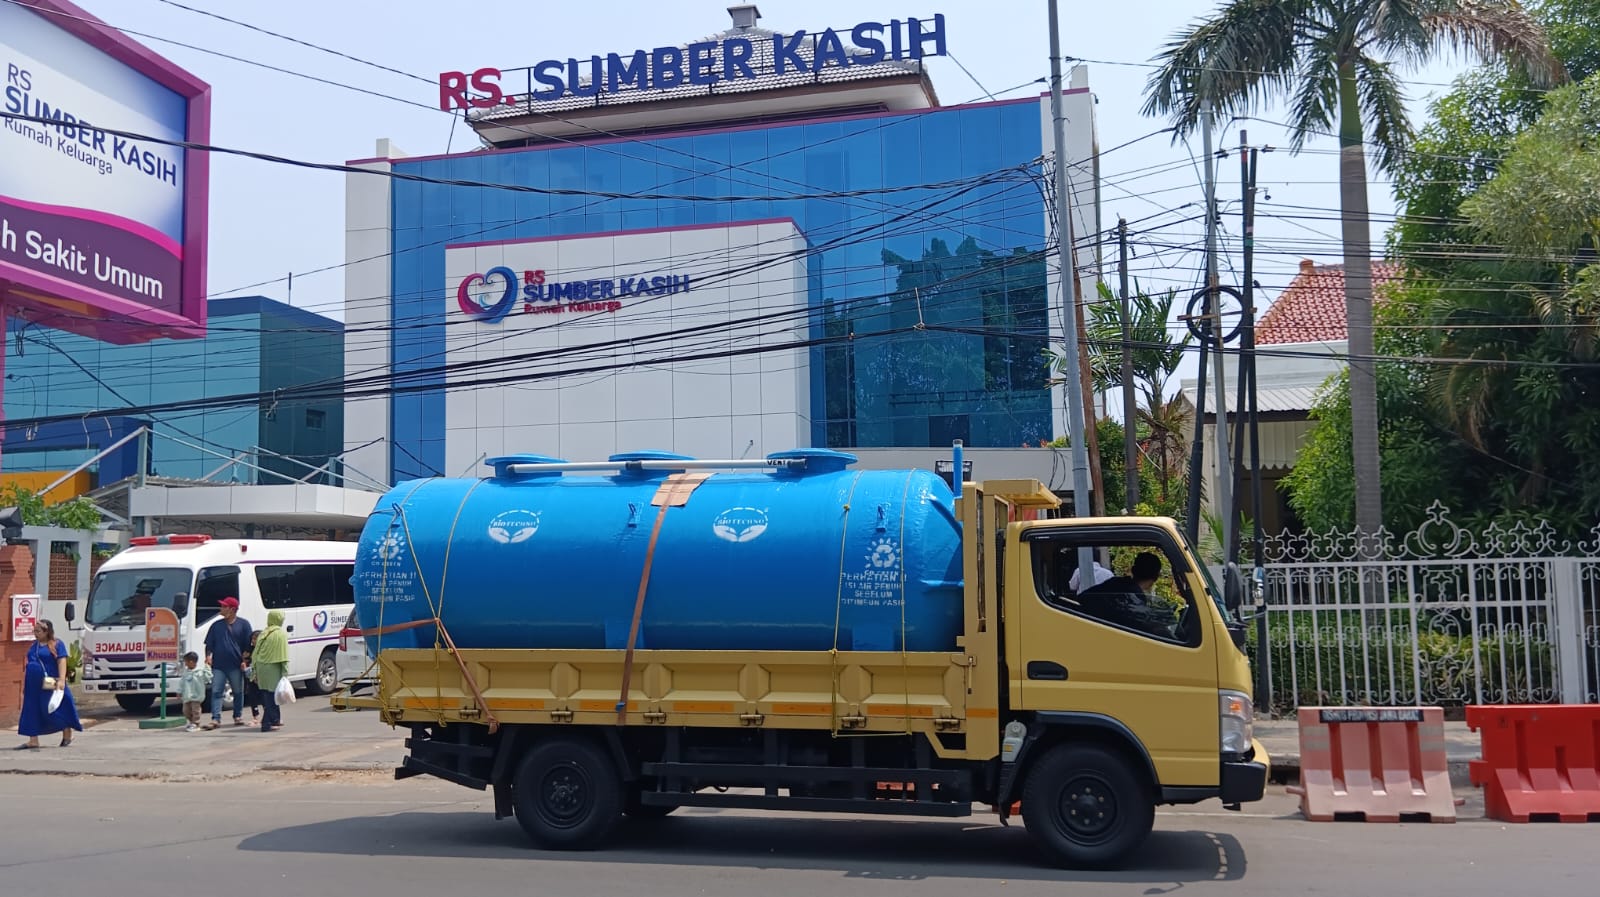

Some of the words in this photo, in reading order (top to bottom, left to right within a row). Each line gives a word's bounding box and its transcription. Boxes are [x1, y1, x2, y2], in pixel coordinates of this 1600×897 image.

[7, 63, 32, 91] RS
[439, 67, 517, 112] RS.
[532, 38, 753, 101] SUMBER
[773, 13, 947, 75] KASIH
[4, 117, 53, 148] Rumah
[57, 138, 113, 175] Keluarga
[5, 85, 106, 154] SUMBER
[113, 135, 177, 186] KASIH
[25, 230, 88, 275] Sakit
[94, 253, 163, 299] Umum
[524, 270, 545, 285] RS
[524, 279, 615, 303] SUMBER
[620, 274, 690, 297] KASIH
[569, 300, 622, 313] Keluarga
[149, 611, 156, 621] P
